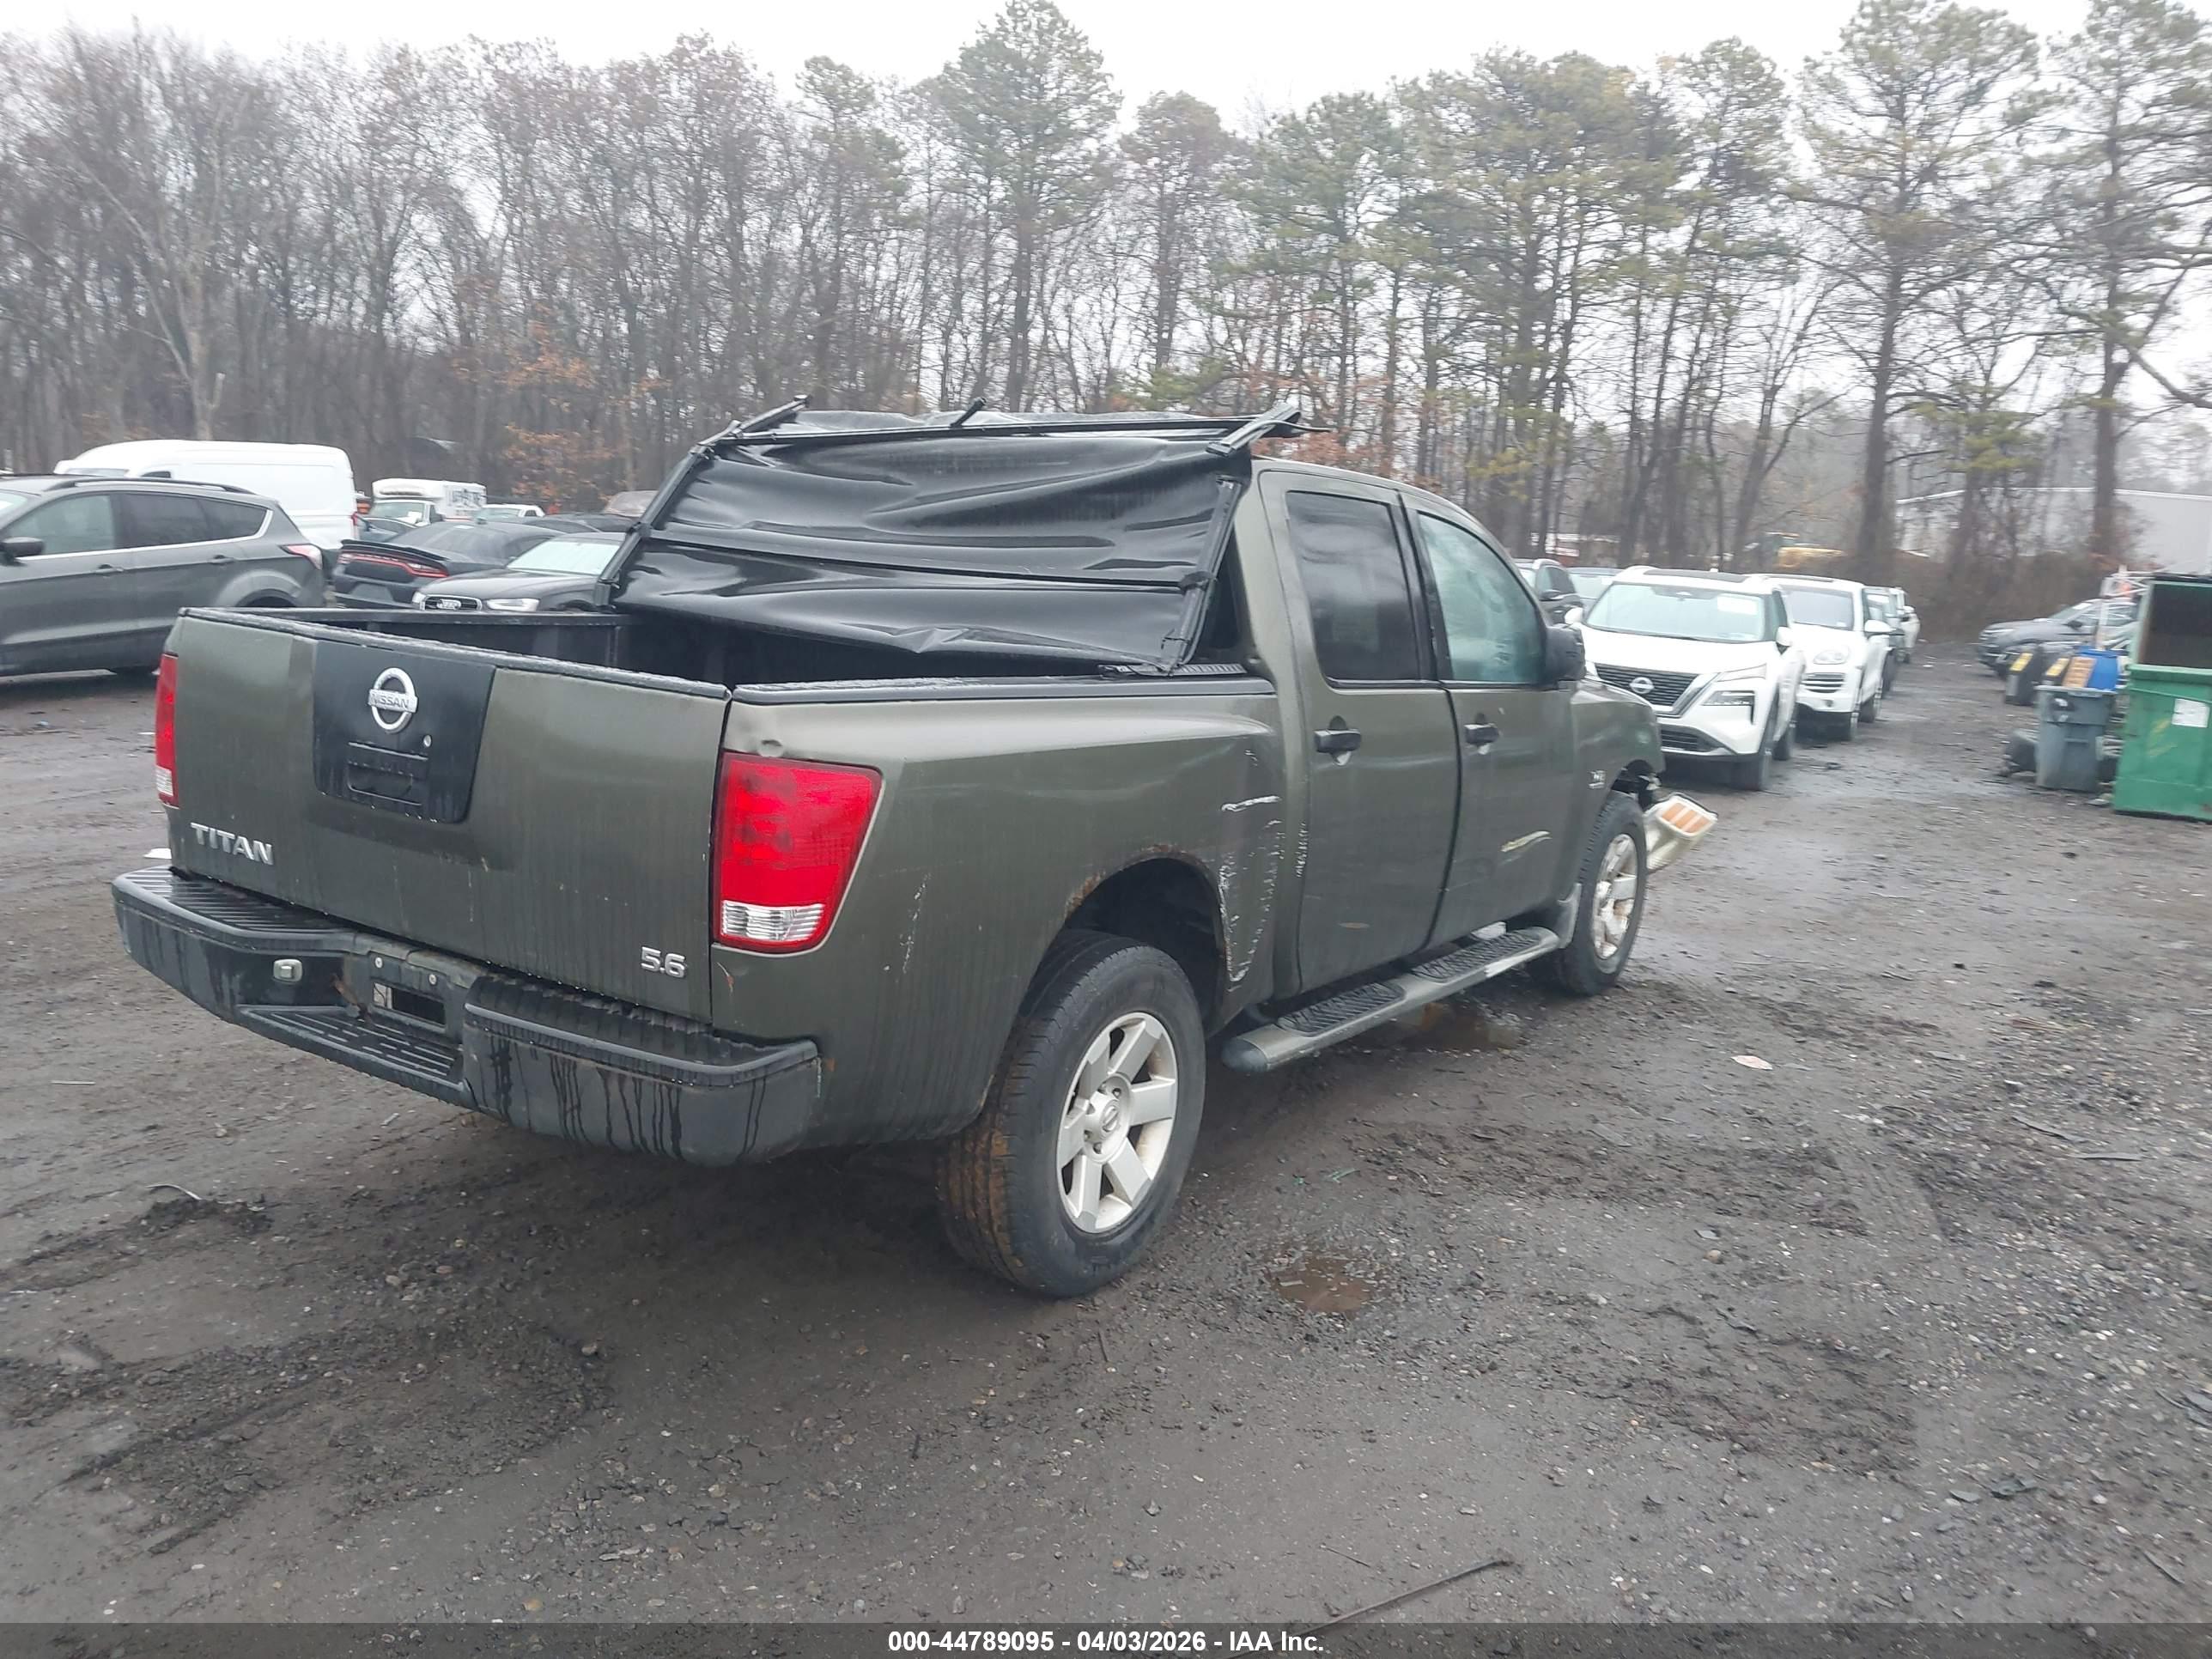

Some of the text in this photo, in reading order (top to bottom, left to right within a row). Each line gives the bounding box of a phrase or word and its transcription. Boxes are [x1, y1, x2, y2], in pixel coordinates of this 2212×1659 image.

[370, 692, 410, 709] NISSAN
[190, 822, 274, 866] TITAN
[641, 945, 685, 978] 5.6
